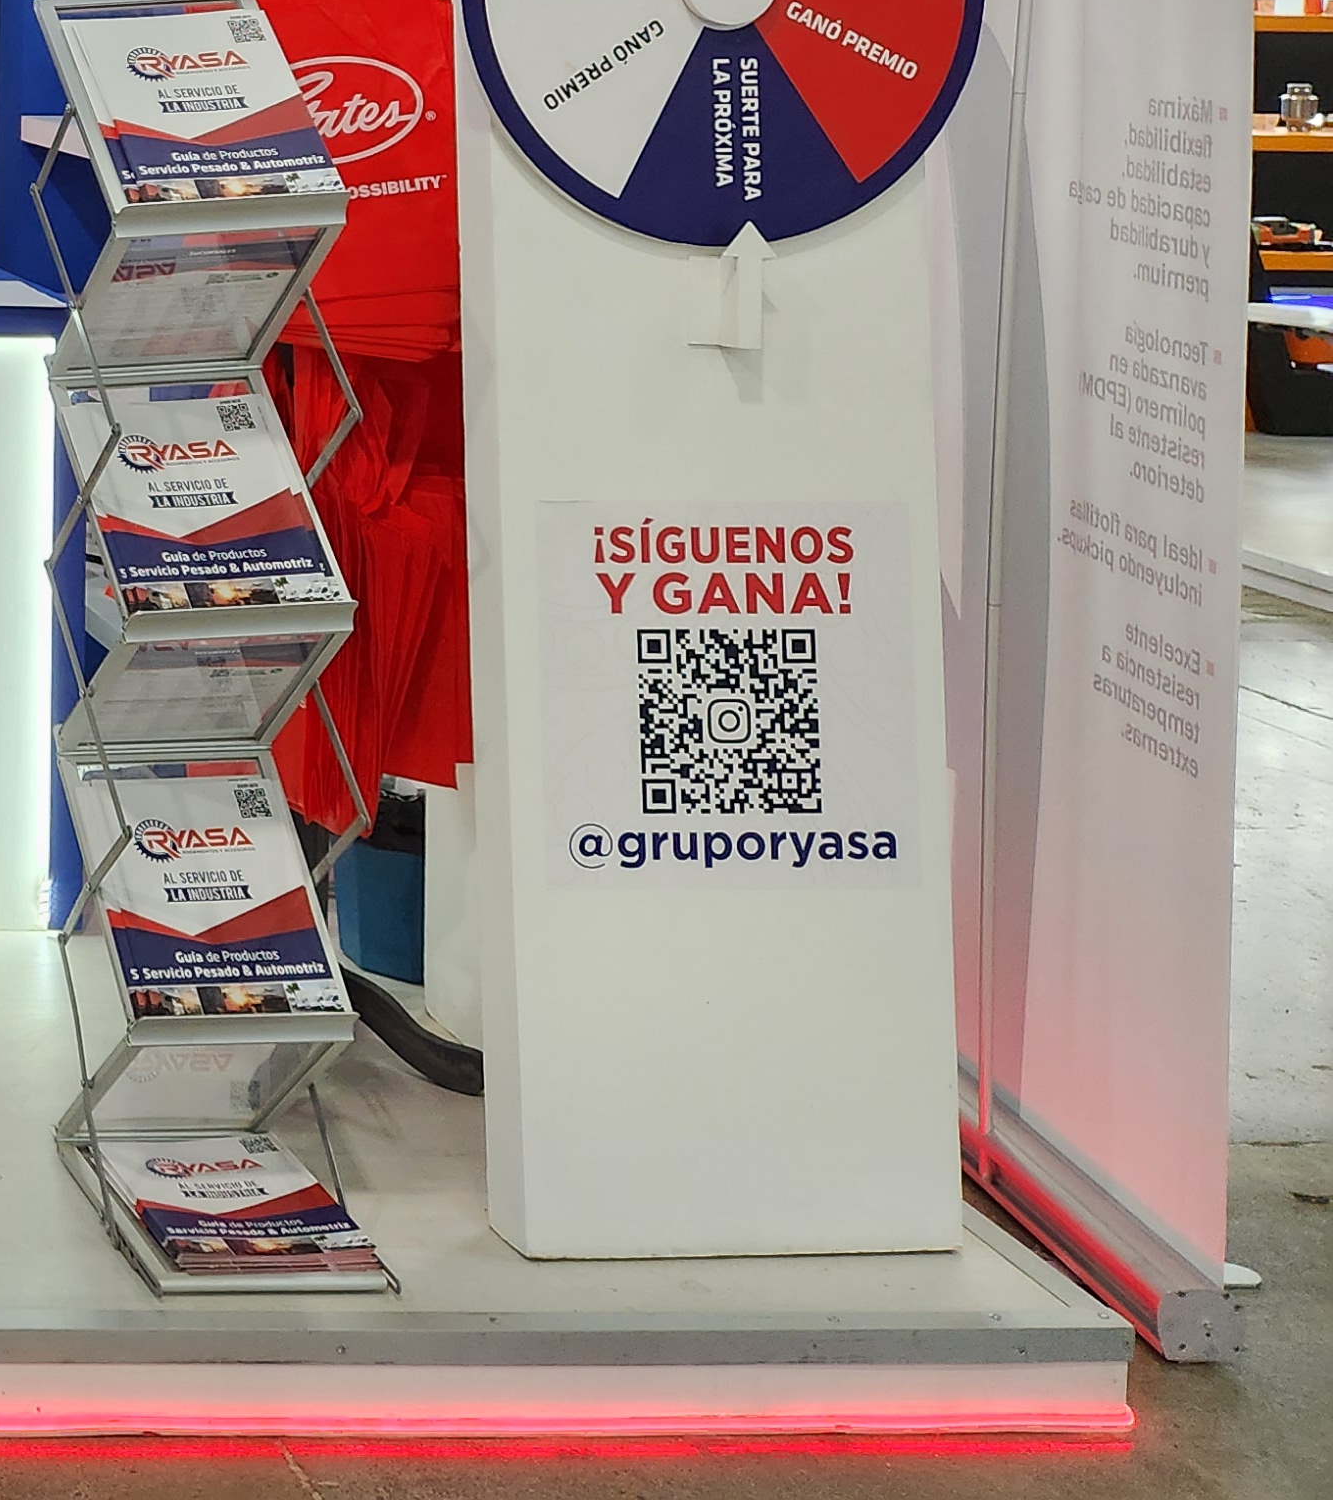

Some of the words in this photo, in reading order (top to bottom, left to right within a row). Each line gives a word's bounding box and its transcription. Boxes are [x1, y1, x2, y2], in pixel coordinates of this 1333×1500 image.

[612, 19, 665, 65] GANÓ
[786, 1, 842, 40] GANÓ
[841, 30, 918, 80] PREMIO
[137, 50, 249, 78] RYASA
[712, 58, 731, 85] LA
[158, 89, 171, 99] AL
[174, 86, 223, 99] SERVICIO
[225, 85, 240, 95] DE
[543, 55, 614, 111] PREMIO
[165, 102, 181, 113] LA
[183, 97, 242, 112] INDUSTRIA
[740, 57, 760, 138] SUERTE
[713, 89, 736, 187] PRÓXIMA
[138, 162, 190, 175] Servicio
[192, 161, 238, 174] Pesado
[240, 160, 252, 171] &
[254, 154, 325, 169] Automotriz
[172, 150, 200, 162] Guía
[202, 150, 218, 161] de
[220, 147, 279, 161] Productos
[742, 142, 762, 201] PARA
[127, 438, 237, 470] RYASA
[148, 481, 162, 493] AL
[165, 480, 211, 492] SERVICIO
[214, 477, 229, 489] DE
[156, 496, 172, 507] LA
[173, 493, 232, 507] INDUSTRIA
[594, 517, 854, 564] ¡SÍGUENOS
[161, 551, 190, 563] Guía
[192, 551, 207, 561] de
[209, 548, 267, 561] Productos
[130, 565, 179, 578] Servicio
[181, 564, 227, 576] Pesado
[230, 562, 241, 573] &
[244, 557, 314, 572] Automotriz
[595, 573, 636, 614] Y
[653, 573, 852, 615] GANA!
[144, 827, 253, 858] RYASA
[569, 823, 898, 869] @gruporyasa
[163, 872, 177, 884] AL
[180, 871, 227, 883] SERVICIO
[230, 870, 244, 881] DE
[170, 889, 186, 900] LA
[188, 886, 246, 900] INDUSTRIA
[175, 950, 204, 963] Guía
[206, 951, 220, 962] de
[222, 949, 280, 962] Productos
[142, 966, 192, 979] Servicio
[195, 965, 240, 979] Pesado
[243, 965, 254, 976] &
[256, 961, 326, 976] Automotriz
[155, 1157, 264, 1179] RYASA
[240, 1218, 303, 1228] Productos
[281, 1221, 351, 1236] Automotriz
